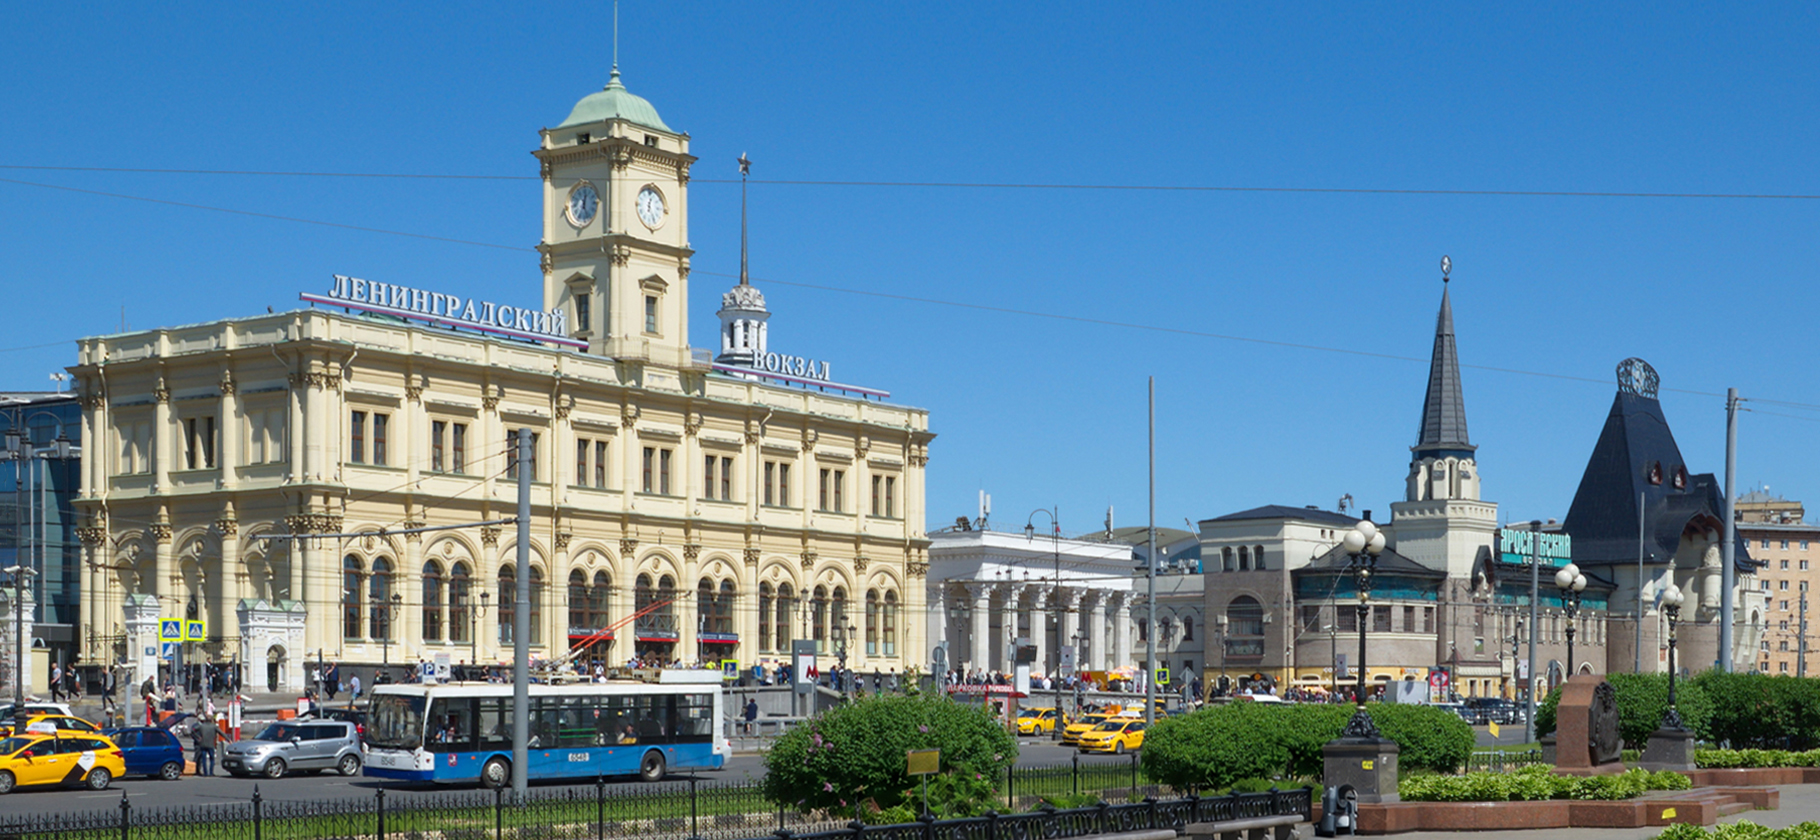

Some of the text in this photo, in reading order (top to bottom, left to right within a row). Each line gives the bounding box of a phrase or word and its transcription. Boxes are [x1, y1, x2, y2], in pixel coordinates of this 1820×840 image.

[328, 274, 568, 337] ЛЕНИНГРАДСКИЙ
[751, 349, 830, 380] ВОКЗАЛ
[1500, 528, 1571, 558] ЯРОСЛВСКИЙ
[1522, 556, 1553, 566] ВОЗАЛ
